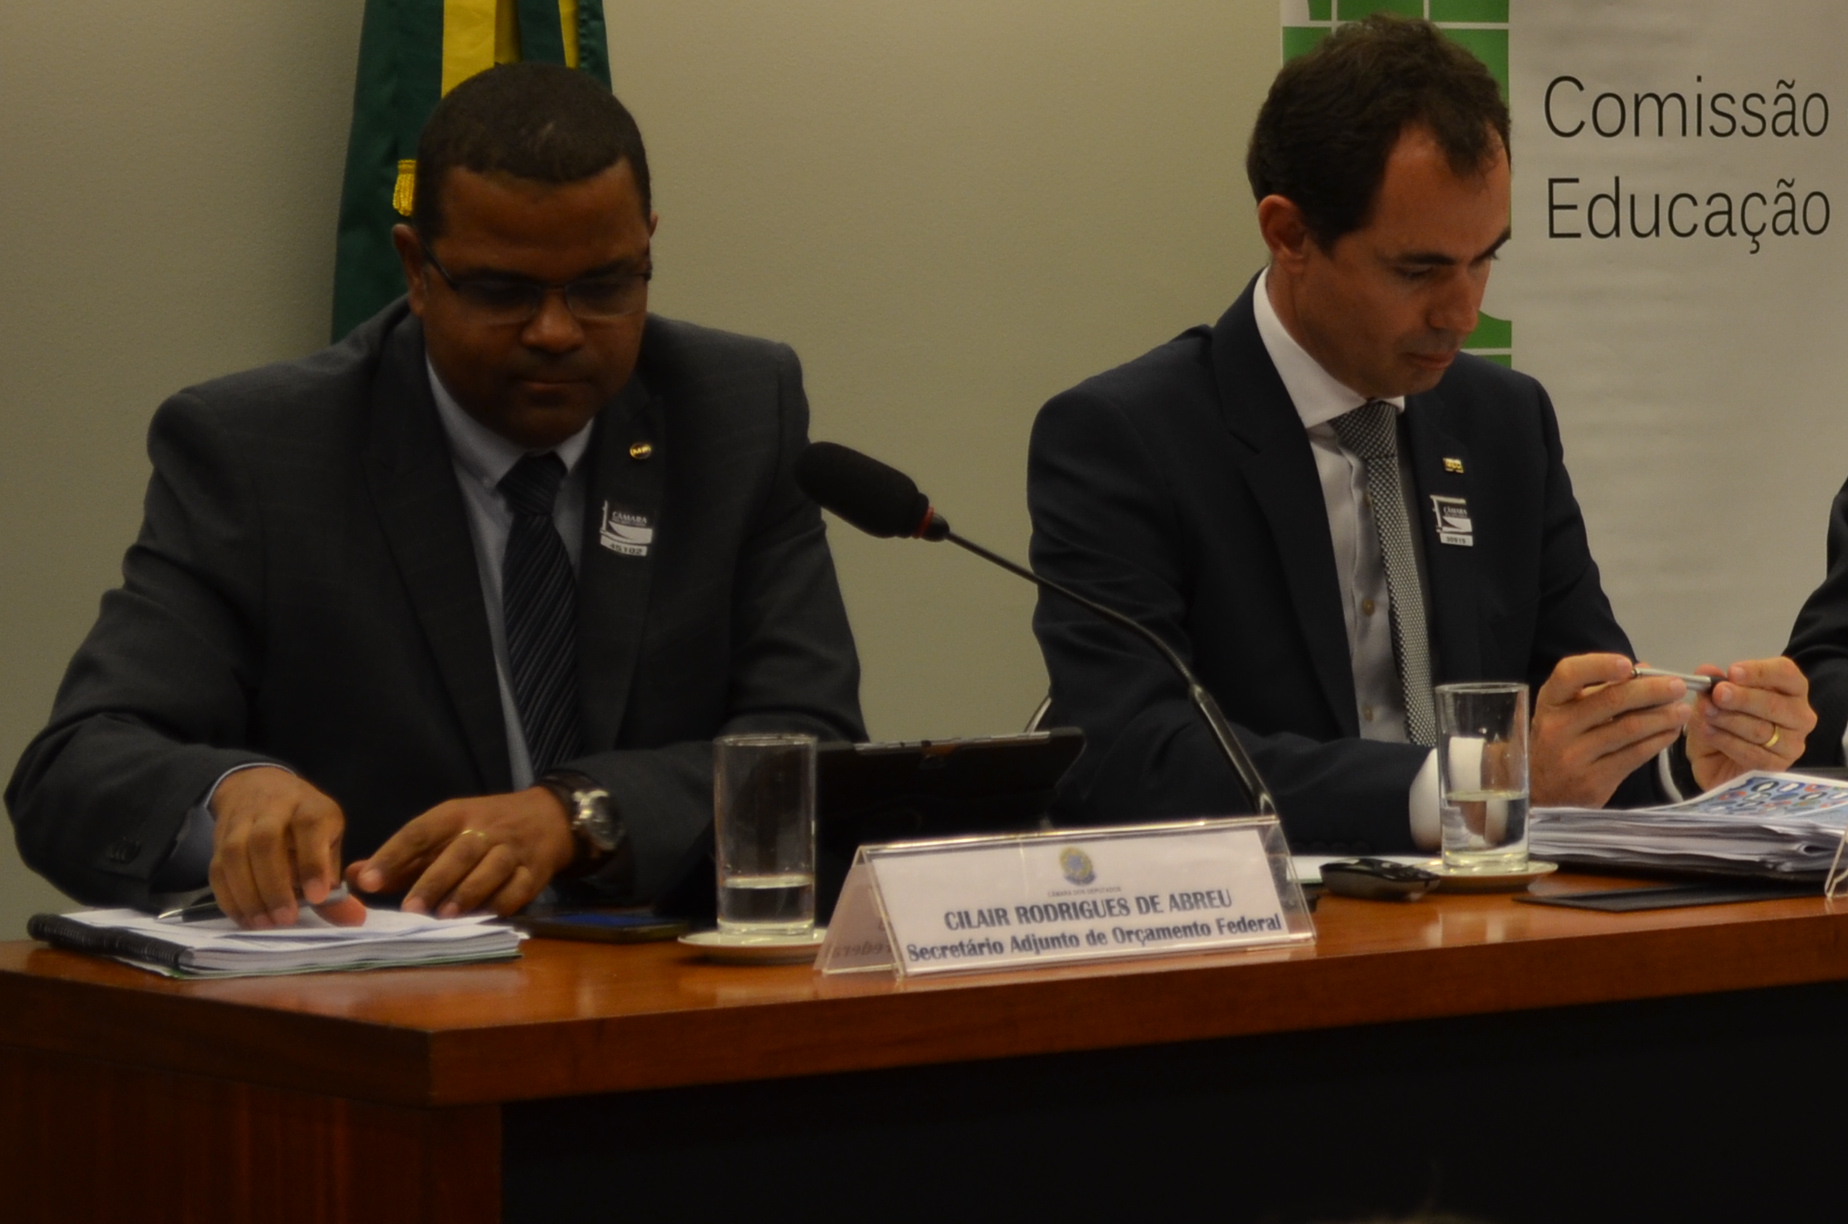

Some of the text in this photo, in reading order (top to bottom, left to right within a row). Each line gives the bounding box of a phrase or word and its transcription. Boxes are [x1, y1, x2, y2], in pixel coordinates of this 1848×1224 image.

[1543, 75, 1830, 138] Comissão
[1547, 176, 1831, 255] Educação
[906, 912, 1283, 963] Secretário Adjunto de Orçamento Federal
[944, 888, 1233, 931] CILAIR RODRIGUES DE ABREU
